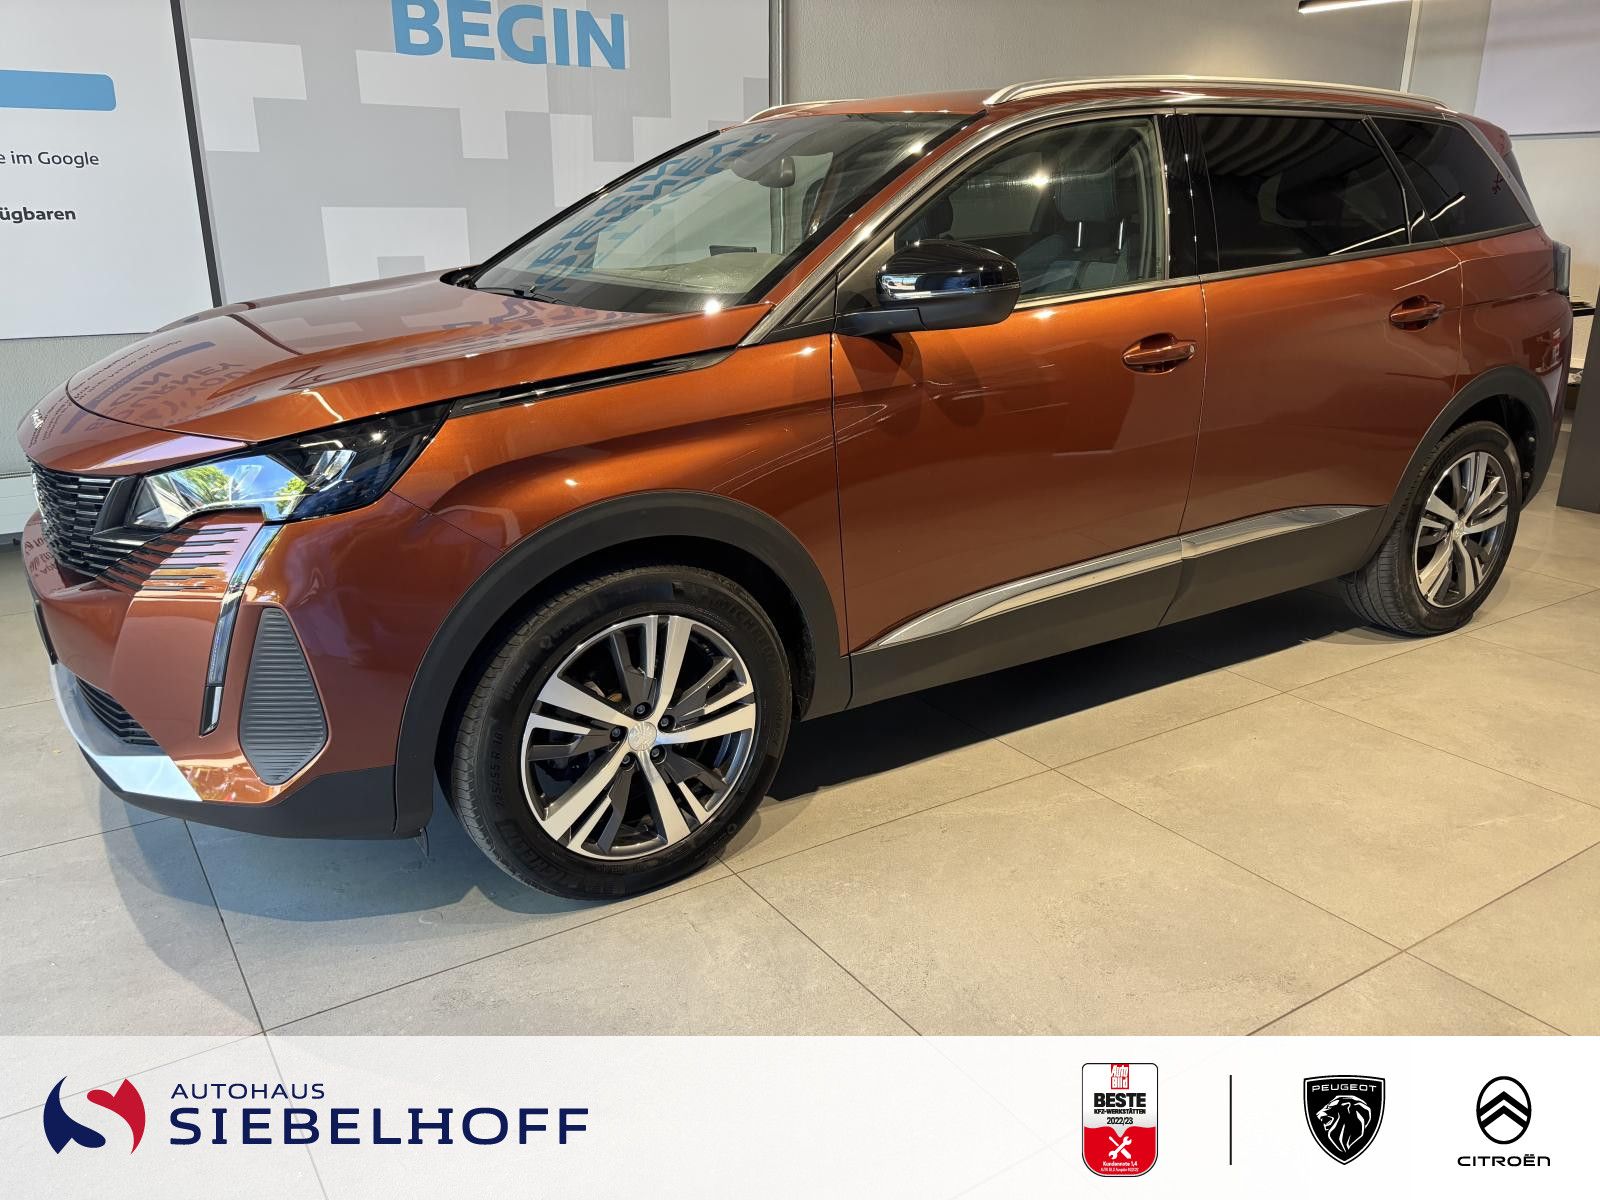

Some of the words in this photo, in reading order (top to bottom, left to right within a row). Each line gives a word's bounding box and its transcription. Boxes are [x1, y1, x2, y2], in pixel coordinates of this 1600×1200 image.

[392, 0, 626, 71] BEGIN
[10, 150, 33, 165] im
[37, 151, 100, 169] Google
